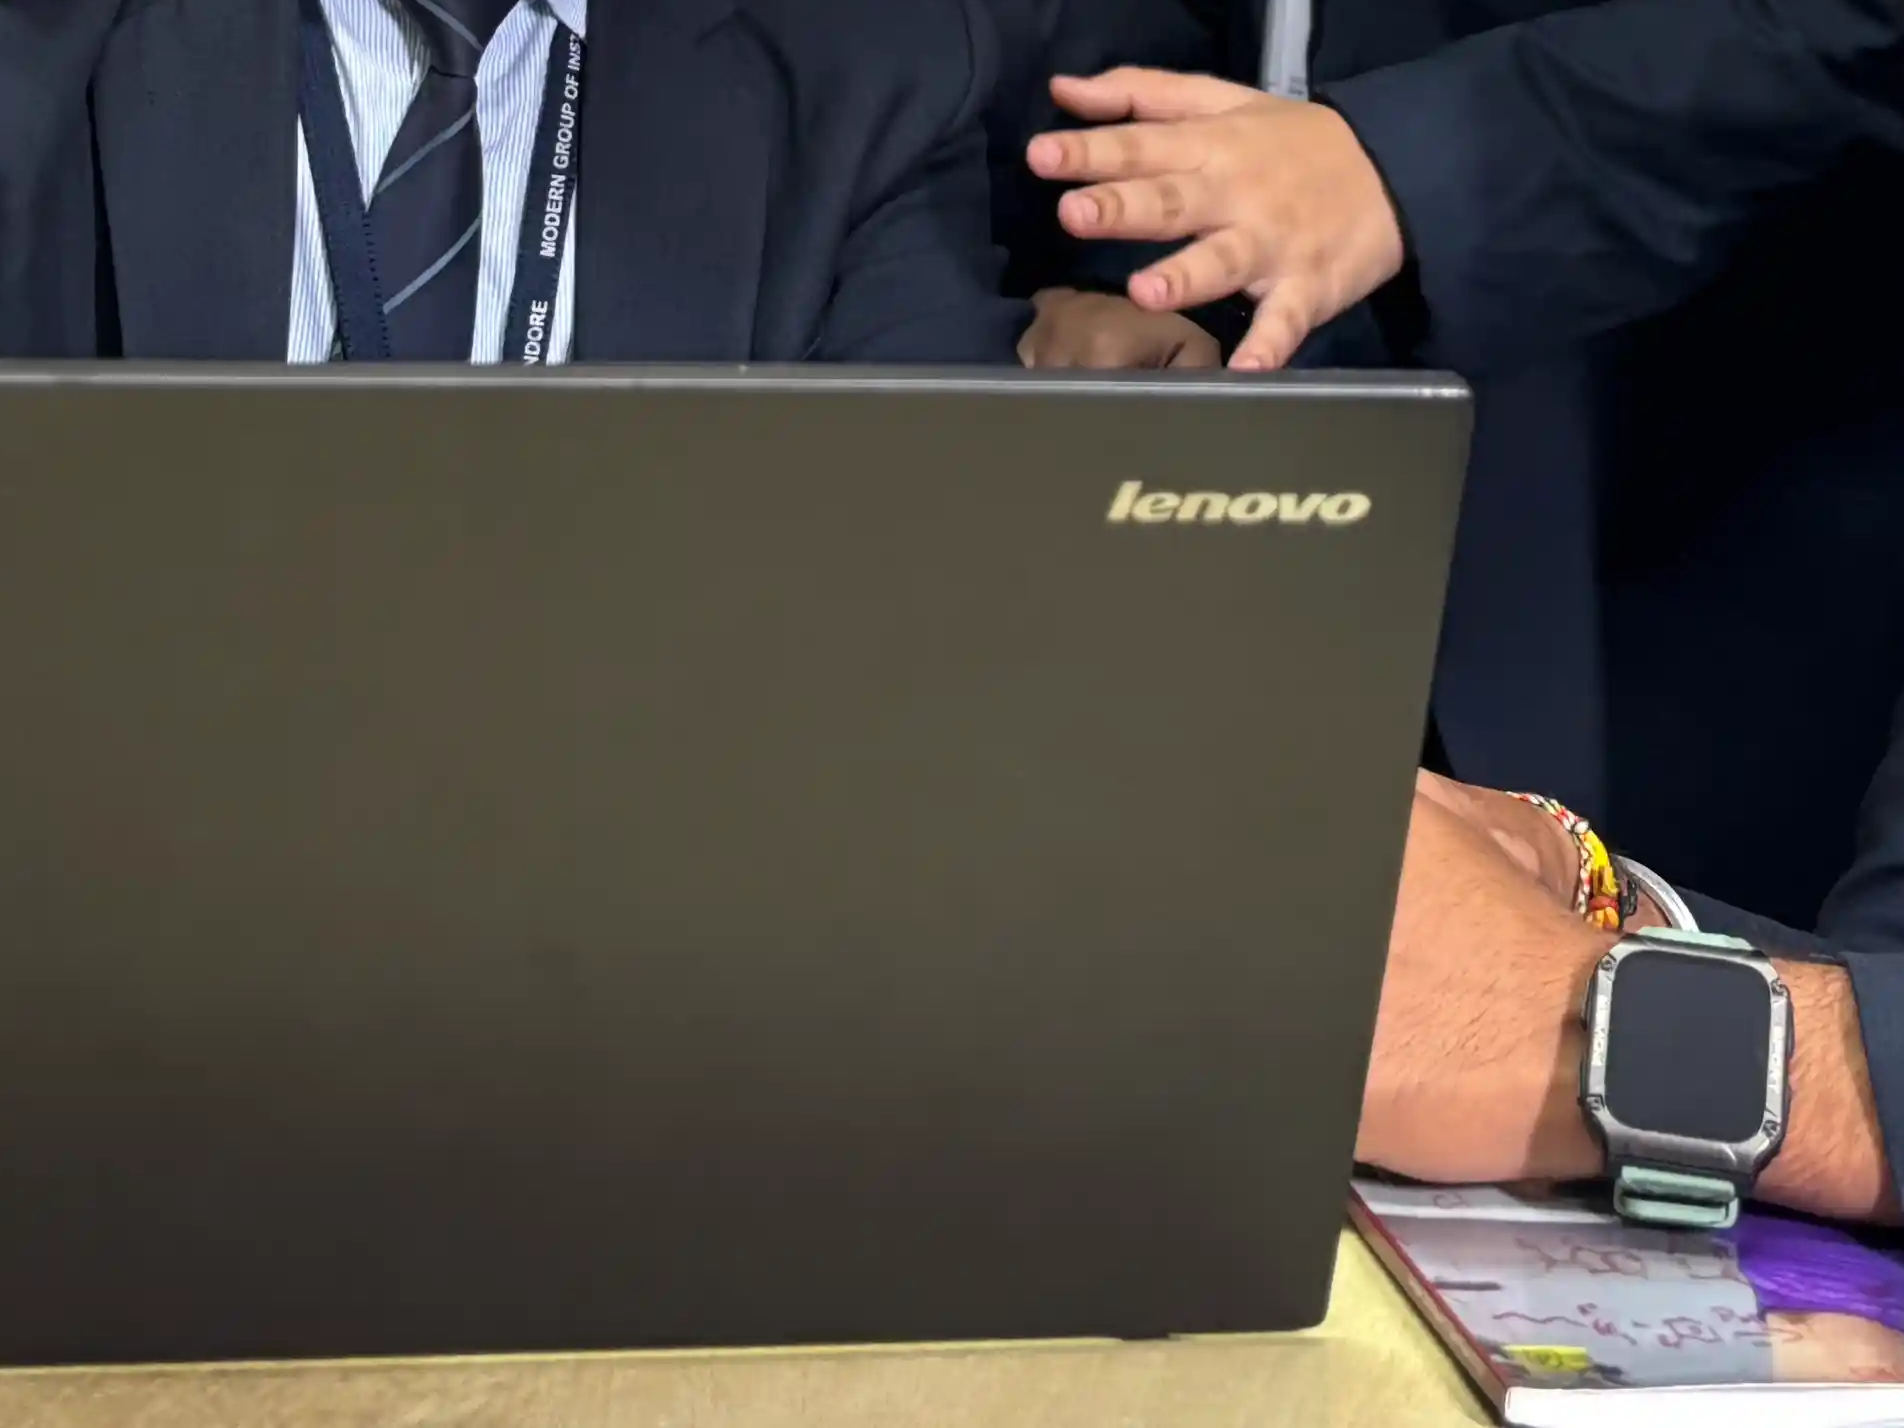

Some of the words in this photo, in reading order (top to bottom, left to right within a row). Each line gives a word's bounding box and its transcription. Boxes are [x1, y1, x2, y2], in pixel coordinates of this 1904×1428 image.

[564, 72, 579, 101] OF
[553, 102, 577, 170] GROUP
[539, 174, 567, 258] MODERN
[523, 299, 548, 366] NDORE
[1106, 479, 1373, 525] lenovo
